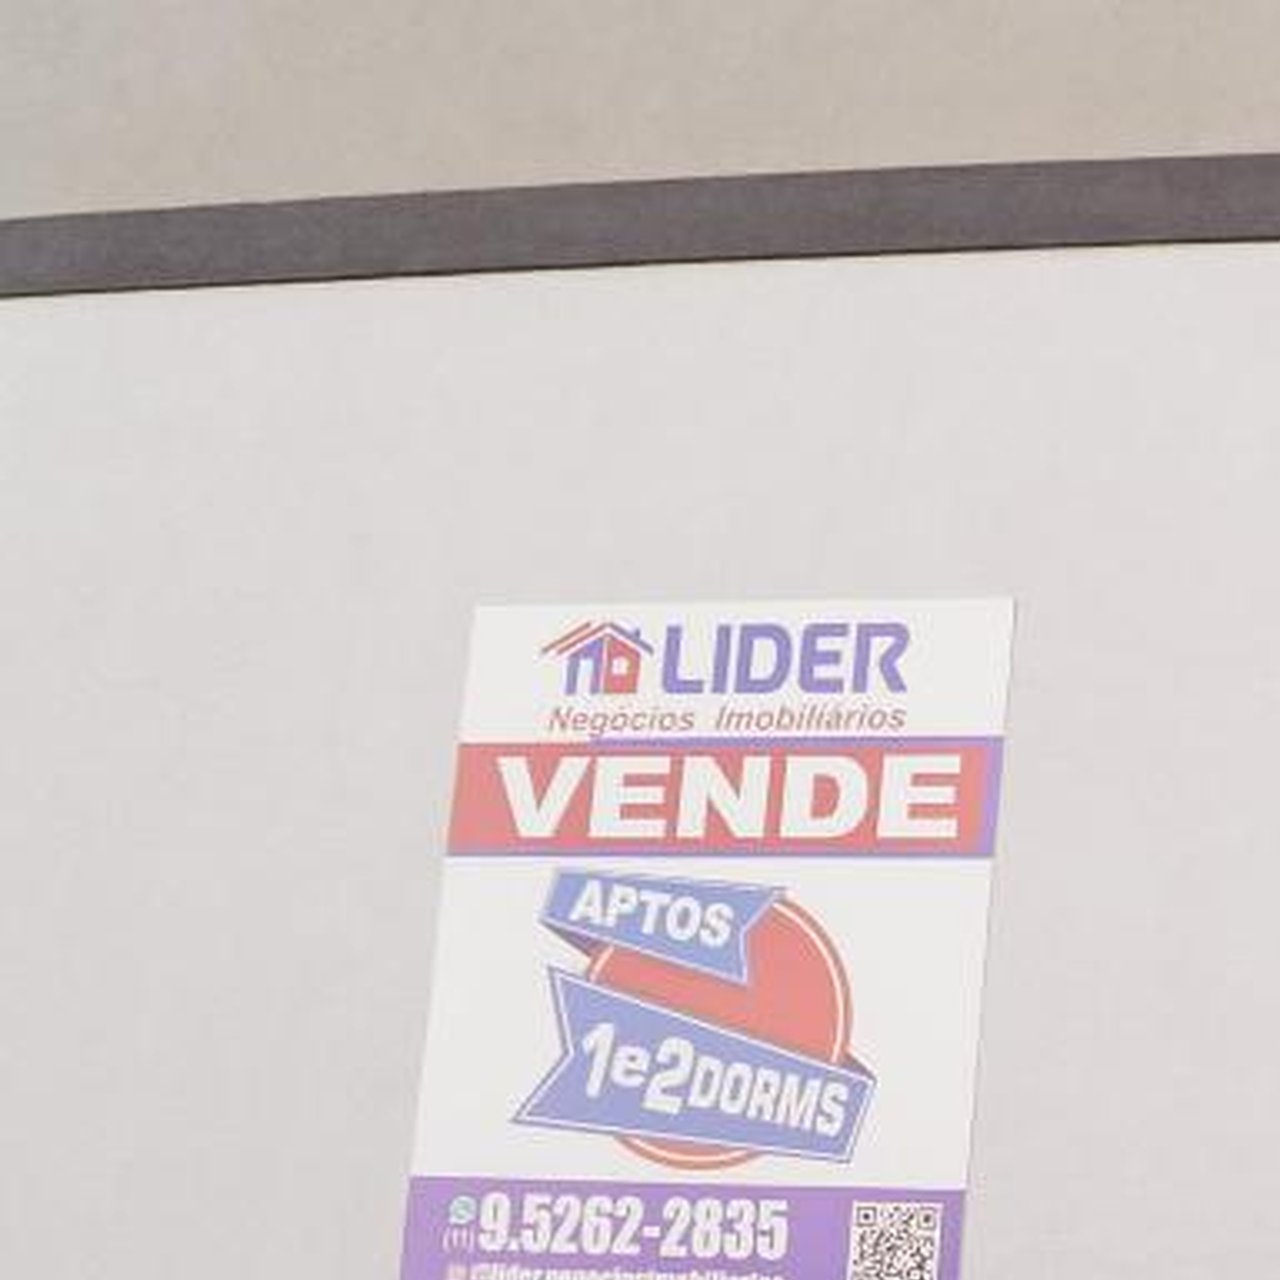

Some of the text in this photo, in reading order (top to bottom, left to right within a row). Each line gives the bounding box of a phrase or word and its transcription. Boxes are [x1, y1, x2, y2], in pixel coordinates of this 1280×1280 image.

[662, 622, 912, 694] LIDER
[548, 701, 908, 737] Negócios Imobiliários
[497, 754, 962, 840] VENDE
[569, 879, 735, 948] APTOS
[478, 1191, 789, 1261] 9.5262-2835
